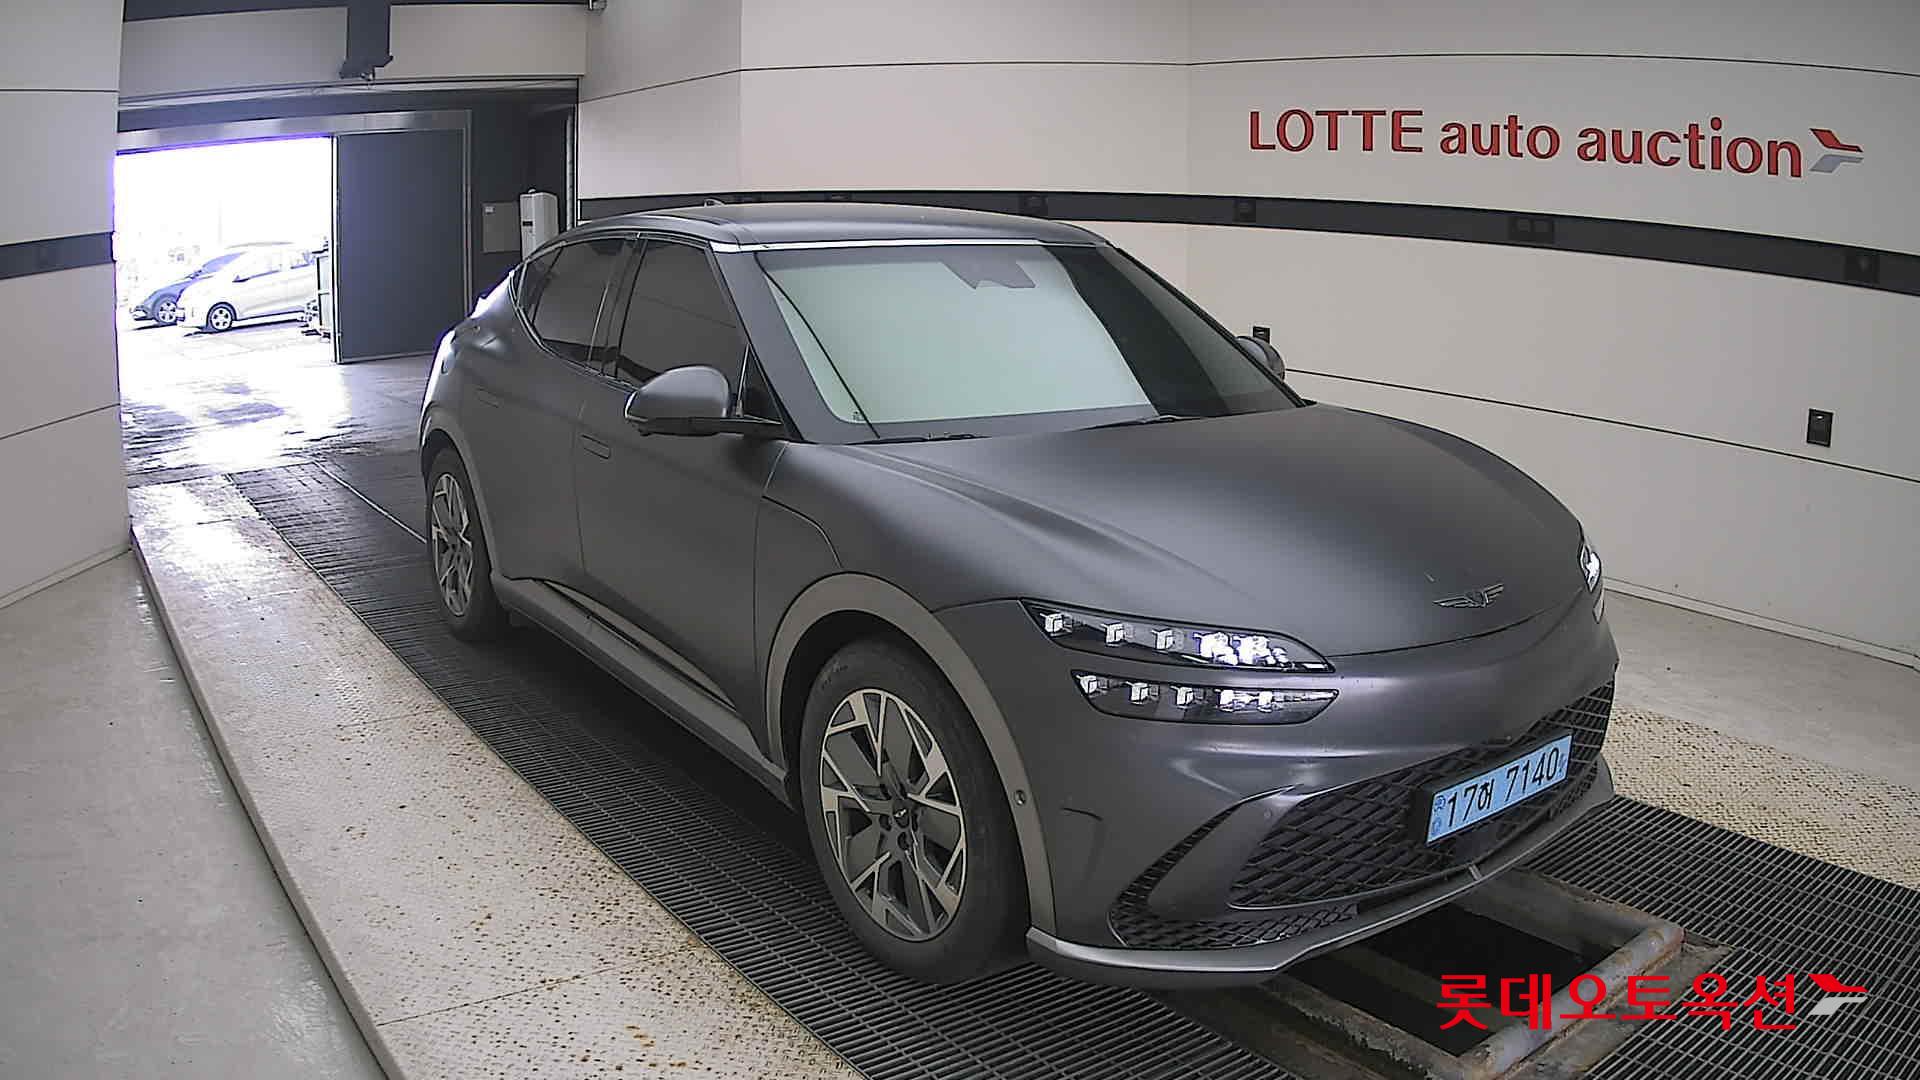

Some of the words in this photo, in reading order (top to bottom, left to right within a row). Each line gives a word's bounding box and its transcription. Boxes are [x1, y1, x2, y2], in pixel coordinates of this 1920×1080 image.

[1249, 109, 1424, 153] LOTTE
[1440, 115, 1561, 160] auto
[1576, 117, 1804, 178] auction
[1447, 778, 1495, 828] 17허
[1504, 747, 1560, 802] 7140
